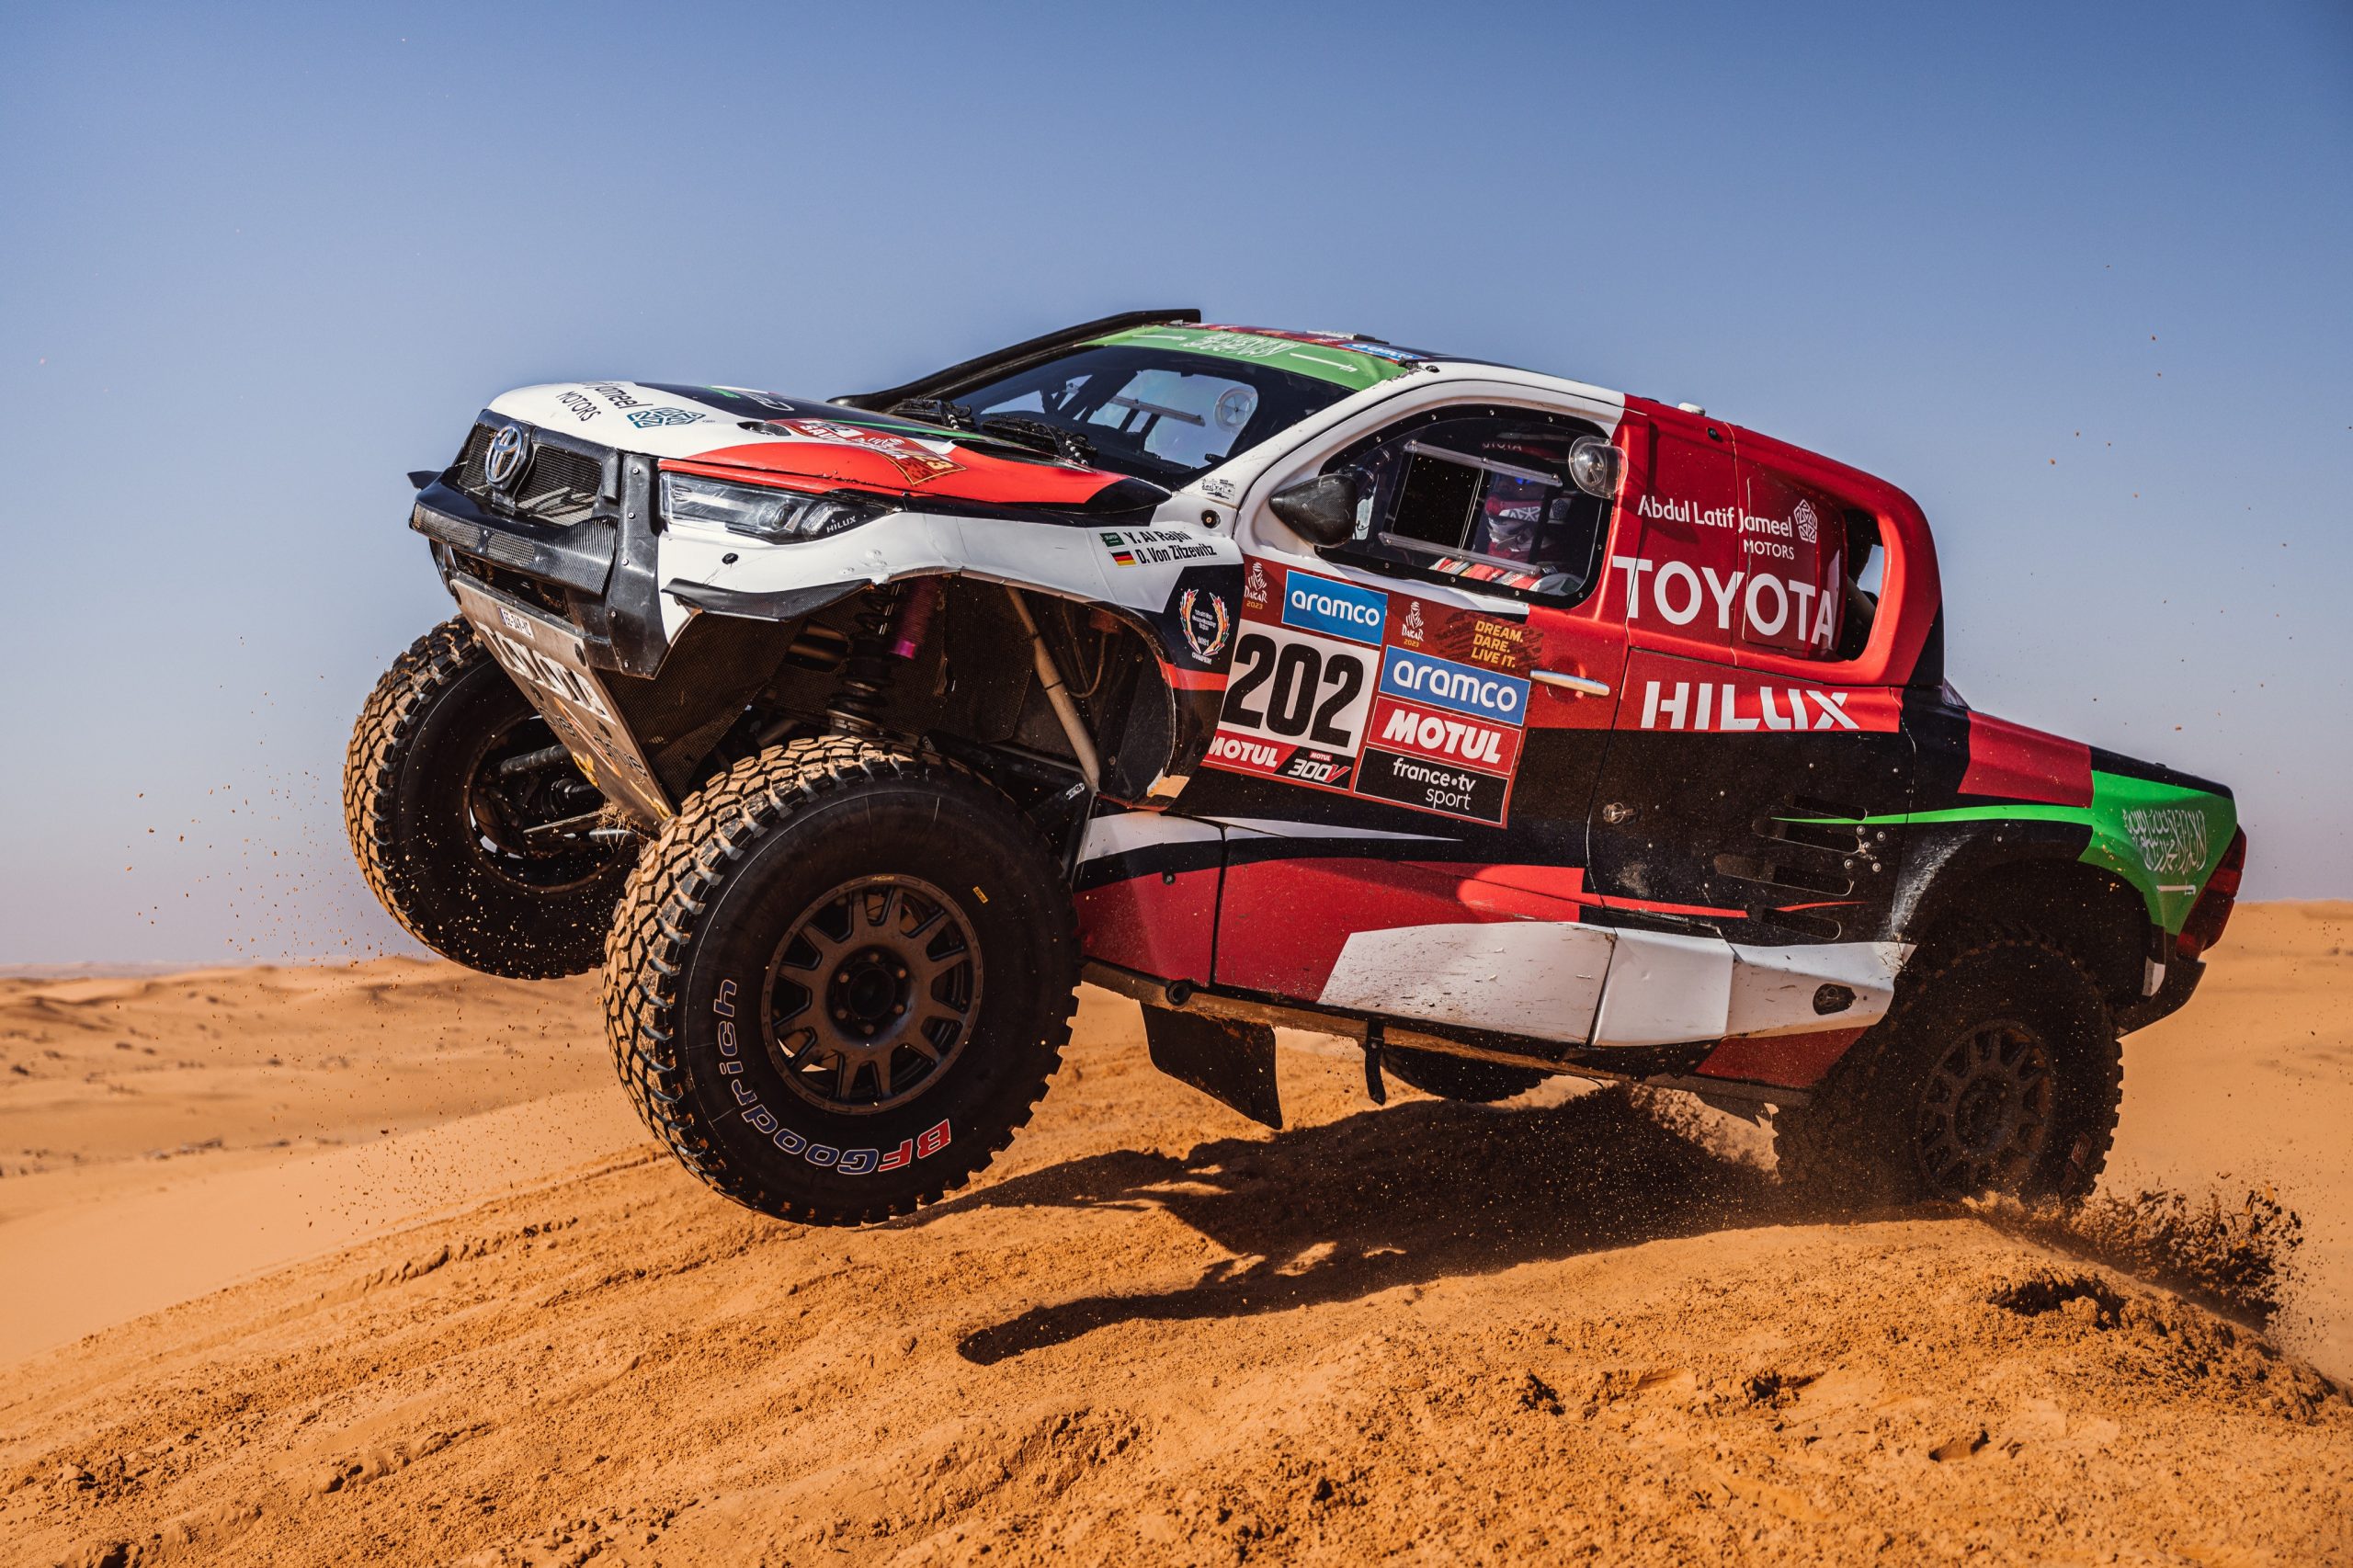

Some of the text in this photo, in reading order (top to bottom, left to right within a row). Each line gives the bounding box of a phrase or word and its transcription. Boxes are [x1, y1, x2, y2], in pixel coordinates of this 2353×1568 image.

[555, 391, 601, 421] MOTORS
[826, 516, 857, 533] HILUX
[1637, 494, 1792, 538] Abdul Latif Jameel
[1123, 532, 1141, 544] Y.
[1143, 531, 1154, 542] Al
[1154, 530, 1193, 543] Rajhi
[1135, 543, 1218, 564] D. Von Zitzewitz
[1744, 540, 1794, 560] MOTORS
[1244, 585, 1268, 604] DAKAR
[1246, 600, 1264, 609] 2023
[1612, 555, 1835, 650] TOYOTA
[1290, 590, 1381, 627] aramco
[1402, 624, 1424, 642] DAKAR
[1474, 620, 1523, 642] DREAM.
[1404, 638, 1419, 648] 2023
[1472, 634, 1510, 653] DARE.
[1471, 647, 1516, 668] LIVE IT.
[474, 619, 617, 726] TOYOTA
[1220, 633, 1364, 748] 202
[1392, 660, 1518, 711] aramco
[1641, 681, 1860, 730] HILUX
[1381, 709, 1501, 764] MOTUL
[1208, 736, 1279, 767] MOTUL
[1310, 752, 1331, 762] MOTUL
[1287, 758, 1351, 783] 300V
[1426, 788, 1472, 811] sport
[713, 979, 951, 1175] BFGoodrich
